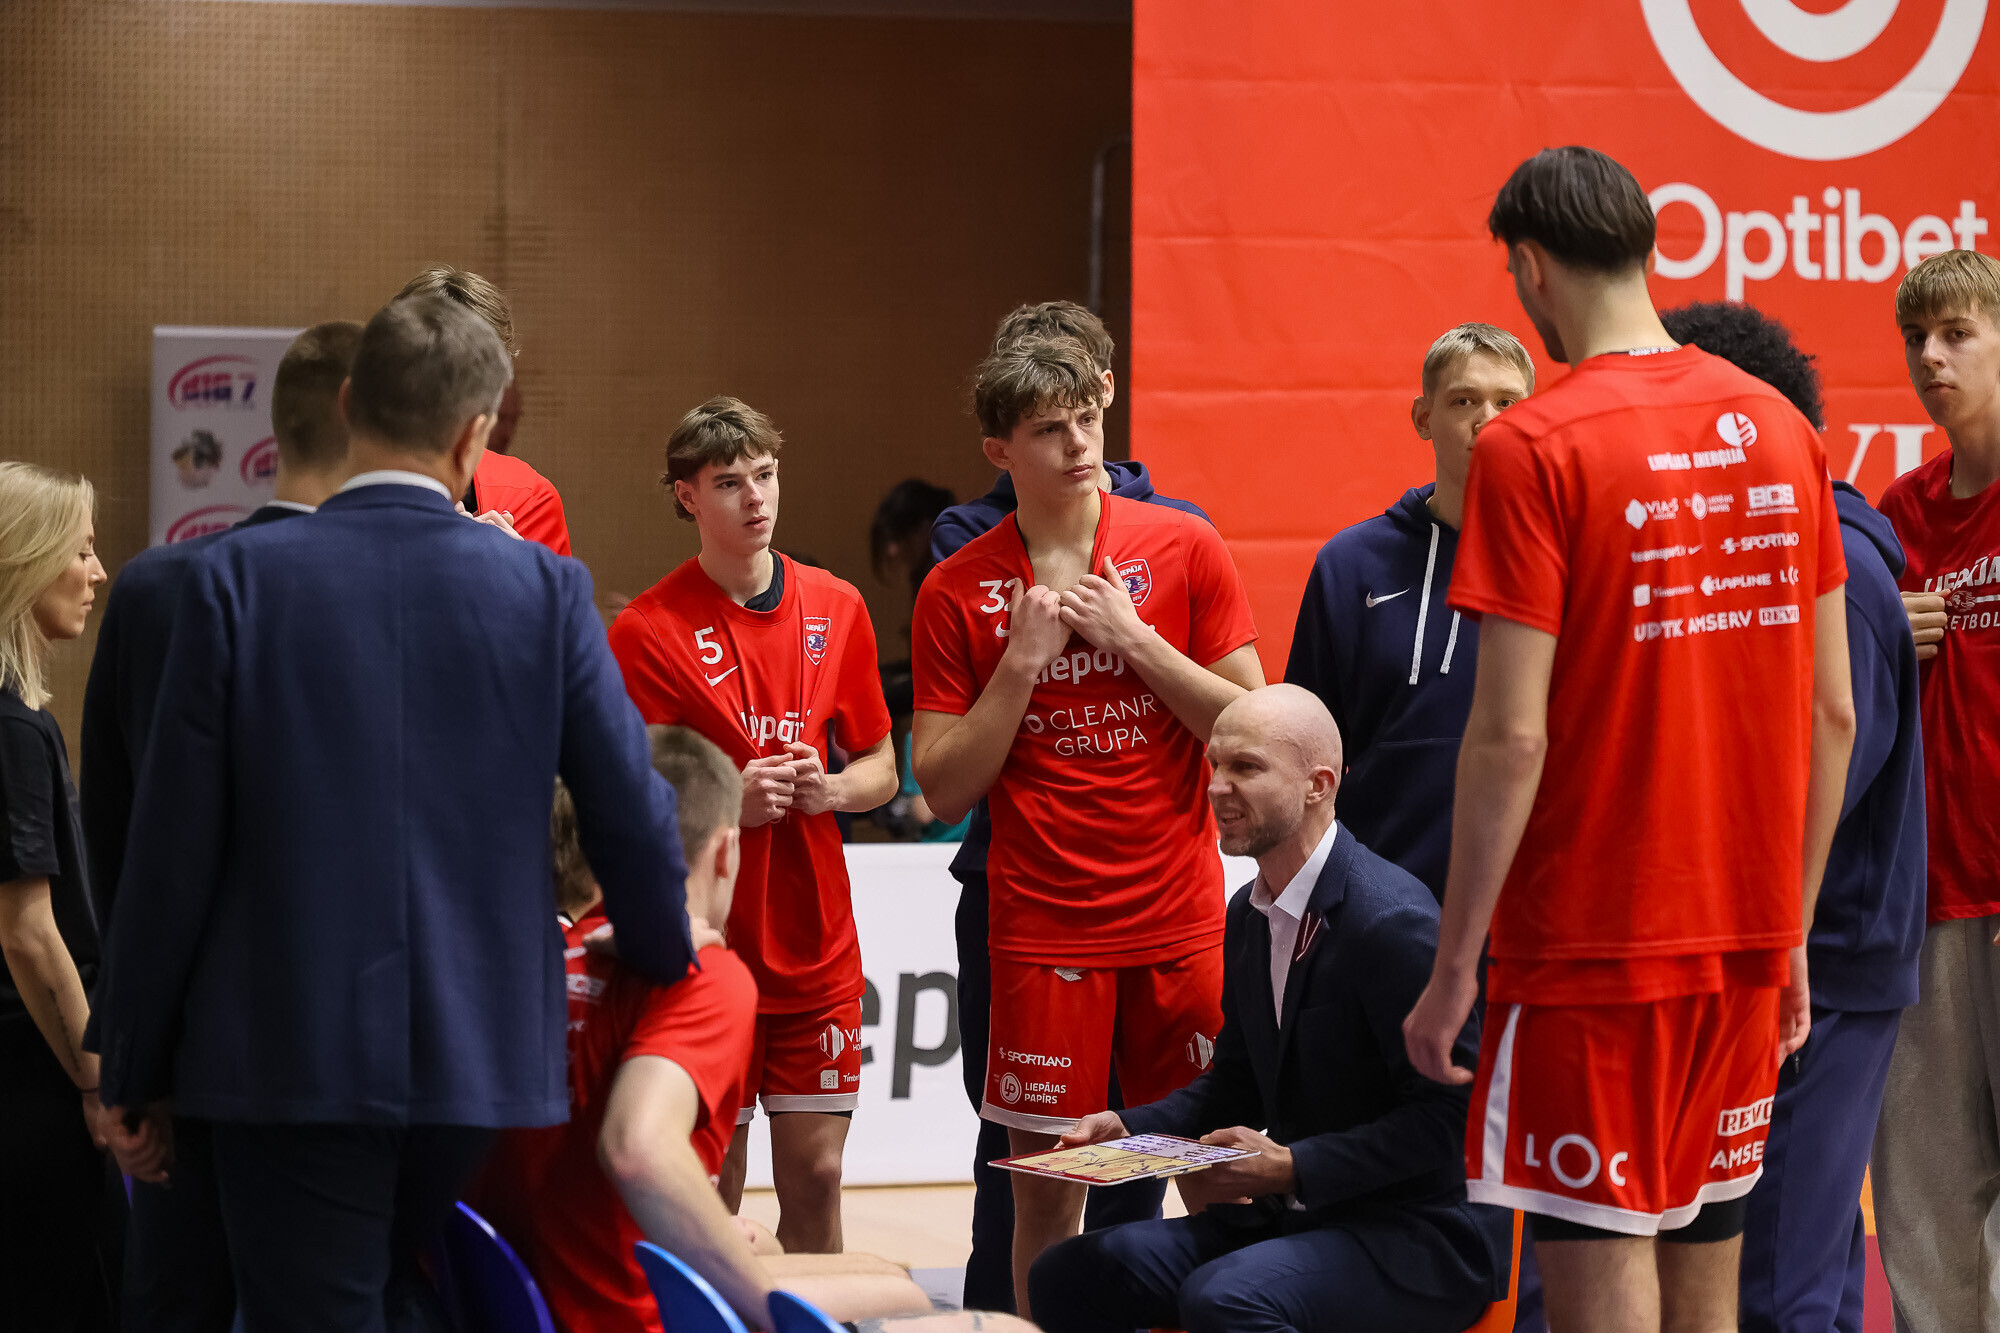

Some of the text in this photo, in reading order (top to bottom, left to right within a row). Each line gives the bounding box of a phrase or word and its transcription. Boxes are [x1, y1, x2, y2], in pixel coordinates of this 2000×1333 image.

[1648, 182, 1989, 303] Optibet
[1687, 608, 1753, 636] AMSERV
[695, 626, 724, 665] 5
[1050, 693, 1157, 730] CLEANR
[1055, 725, 1148, 756] GRUPA
[1007, 1050, 1072, 1068] SPORTLAND
[1024, 1081, 1067, 1094] LIEPĀJAS
[1024, 1093, 1058, 1104] PAPĪRS
[1525, 1133, 1629, 1189] LOC
